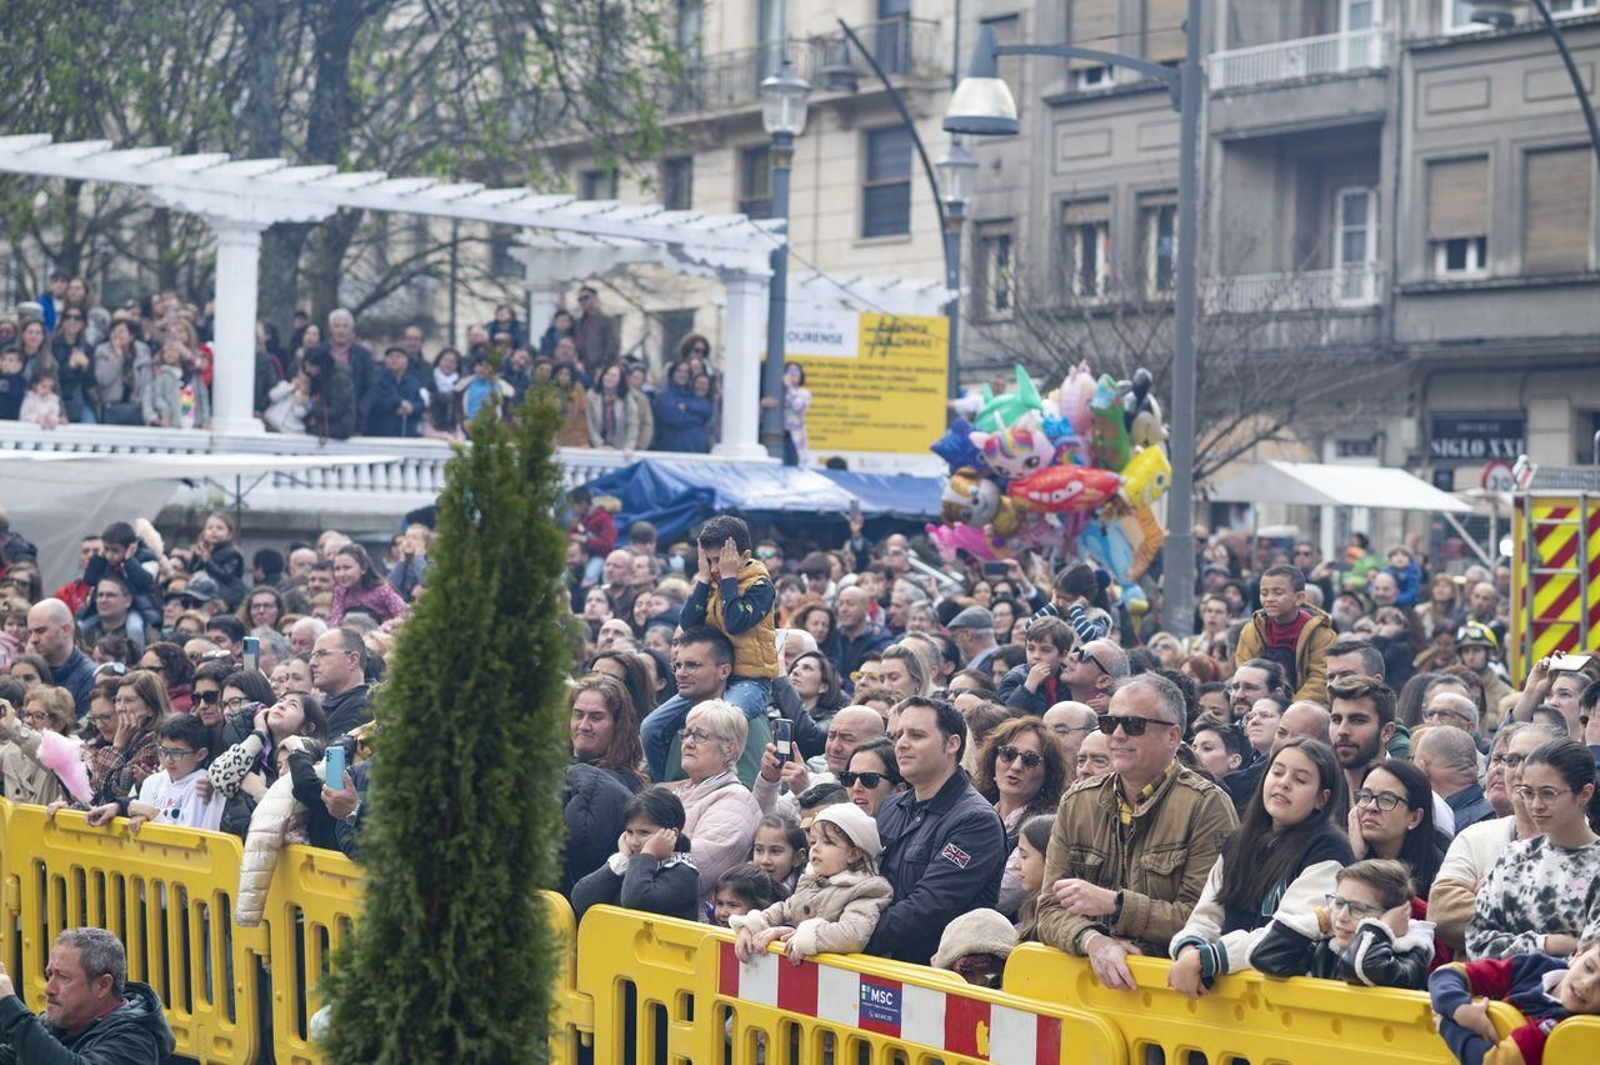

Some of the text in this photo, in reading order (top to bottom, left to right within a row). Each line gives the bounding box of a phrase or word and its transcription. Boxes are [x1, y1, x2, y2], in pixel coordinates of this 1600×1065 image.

[786, 331, 843, 346] OURENSE
[1431, 438, 1525, 458] SIGLO XXI
[870, 988, 893, 1006] MSC
